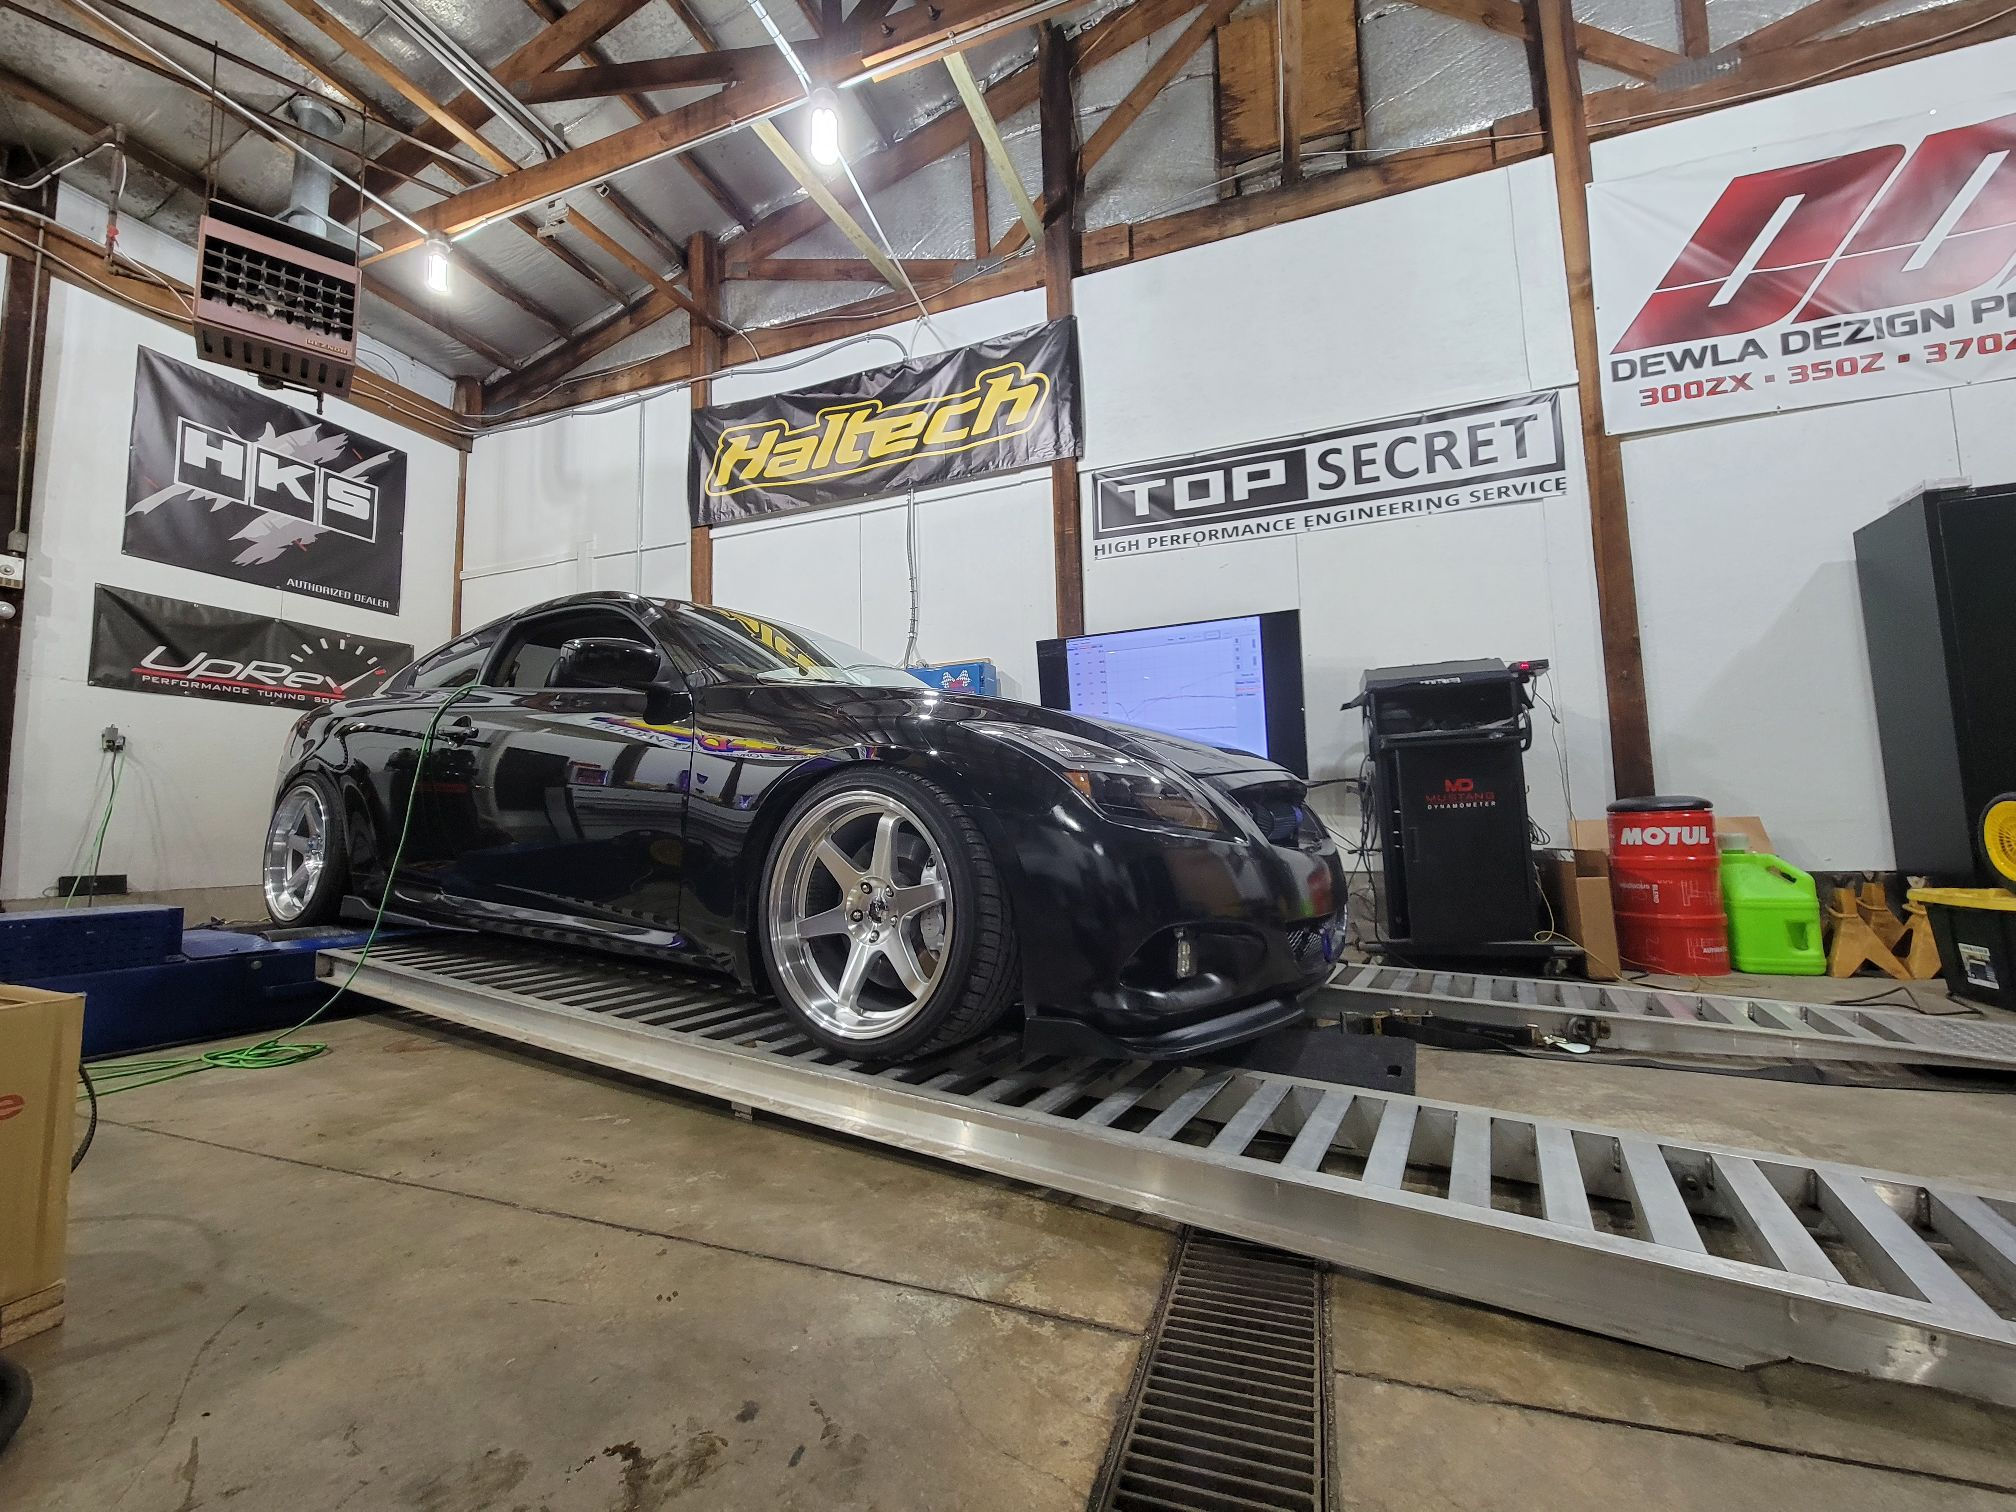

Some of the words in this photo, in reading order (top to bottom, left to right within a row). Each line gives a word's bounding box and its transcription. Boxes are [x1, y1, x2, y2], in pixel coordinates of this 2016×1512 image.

[1610, 338, 1768, 382] DEWLA
[1780, 303, 1955, 356] DEZIGN
[1639, 371, 1754, 407] 300ZX
[1788, 352, 1885, 384] 350Z
[713, 373, 1039, 487] Haltech
[183, 426, 372, 520] HKS
[1117, 459, 1287, 516] TOP
[1317, 414, 1538, 490] SECRET
[1094, 538, 1140, 557] HIGH
[1147, 518, 1296, 548] PERFORMANCE
[1304, 492, 1460, 528] ENGINEERING
[1469, 476, 1568, 503] SERVICE
[286, 577, 351, 600] AUTHORIZED
[354, 593, 389, 609] DEALER
[142, 675, 250, 695] PERFORMANCE
[257, 689, 306, 701] TUNING
[1427, 800, 1496, 811] DYNAMOMETER
[1620, 826, 1710, 846] MOTUL
